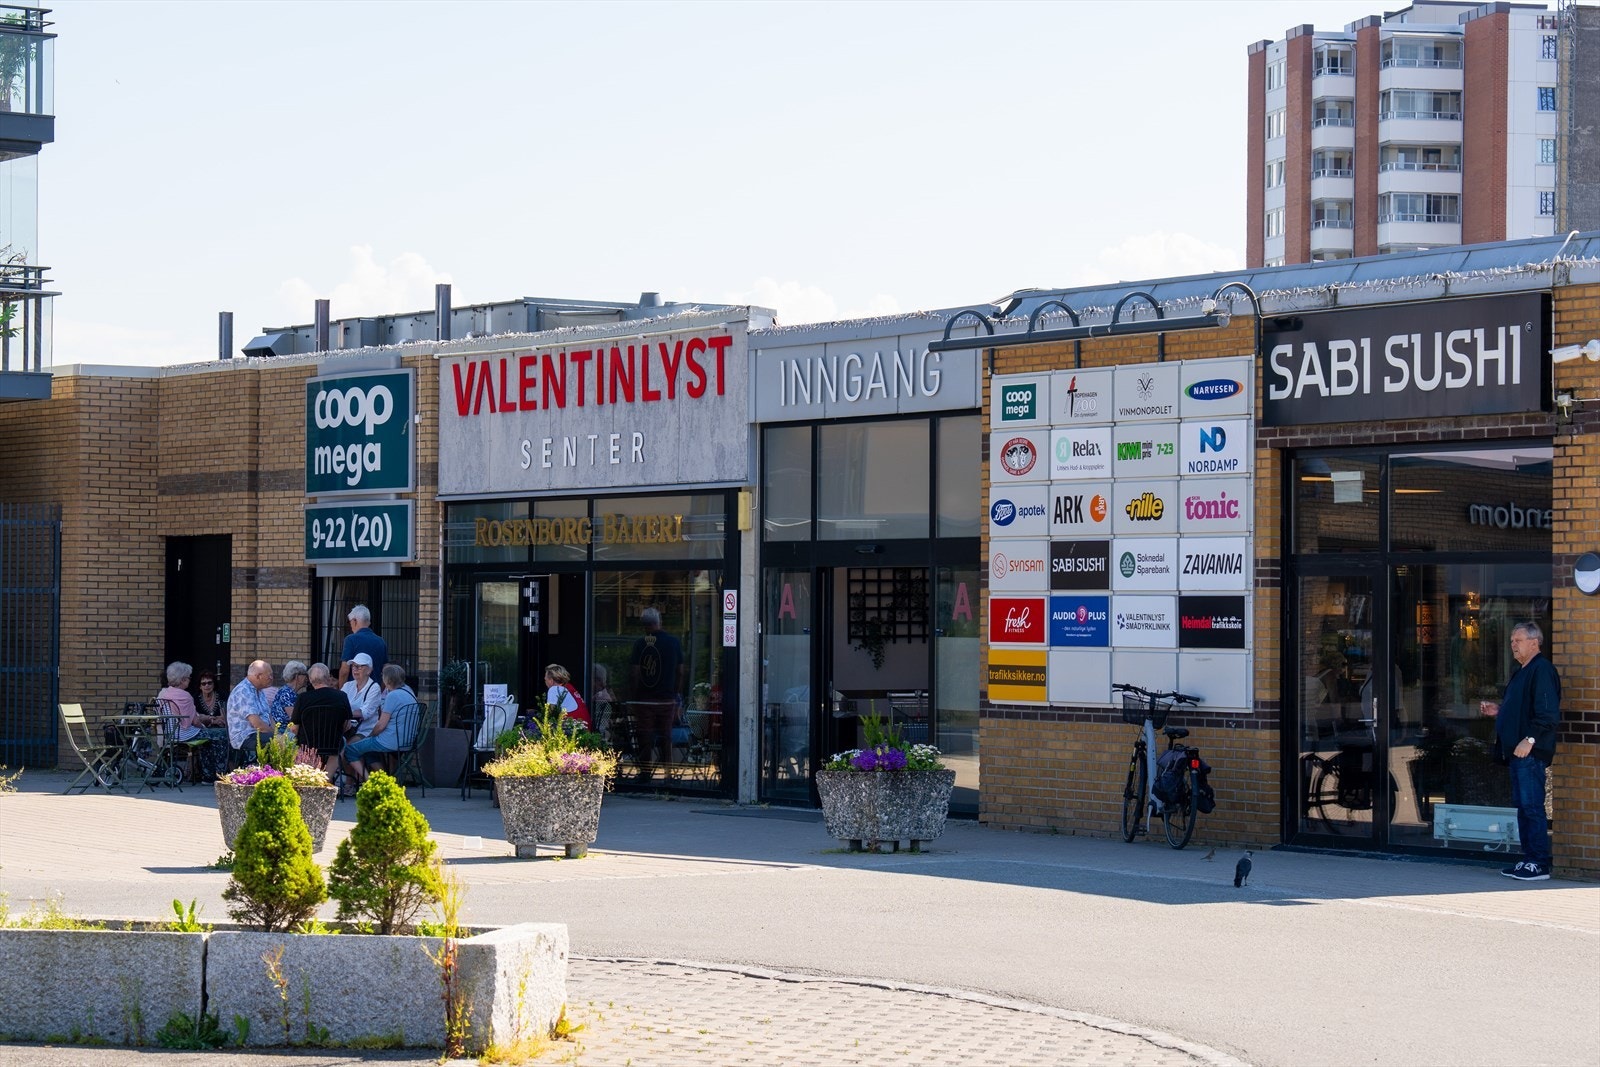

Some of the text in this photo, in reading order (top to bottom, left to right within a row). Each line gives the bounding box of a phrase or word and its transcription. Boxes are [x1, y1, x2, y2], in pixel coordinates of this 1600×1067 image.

[1269, 325, 1521, 400] SABI SUSHI
[452, 336, 733, 416] VALENTINLYST
[780, 349, 942, 406] INNGANG
[1006, 390, 1032, 403] coop
[1193, 385, 1234, 395] NARVESEN
[315, 385, 394, 435] coop
[1006, 405, 1029, 417] mega
[1119, 405, 1172, 416] VINMONOPOLET
[520, 432, 645, 469] SENTER
[1117, 440, 1174, 461] KIWI mini 7-23
[1142, 450, 1152, 460] pris
[314, 443, 381, 486] mega
[1188, 458, 1239, 473] NORDAMP
[1018, 504, 1046, 518] apotek
[1053, 495, 1084, 525] ARK
[1130, 492, 1164, 521] nille
[1185, 491, 1239, 520] tonic
[312, 513, 393, 551] 9-22 (20)
[475, 513, 684, 546] ROSENBORG BAKERI
[1009, 559, 1045, 572] SYNSAM
[1052, 557, 1105, 572] SABI SUSHI
[1136, 553, 1165, 562] Soknedal
[1183, 553, 1242, 575] ZAVANNA
[1136, 565, 1170, 576] Sparebank
[778, 584, 796, 618] A
[952, 582, 972, 620] A
[1005, 606, 1032, 633] fresh
[1052, 611, 1106, 620] AUDIO PLUS
[1125, 613, 1165, 621] VALENTINLYST
[1182, 615, 1242, 630] Heimdal trafikkskole
[989, 669, 1046, 682] trafikksikker.no
